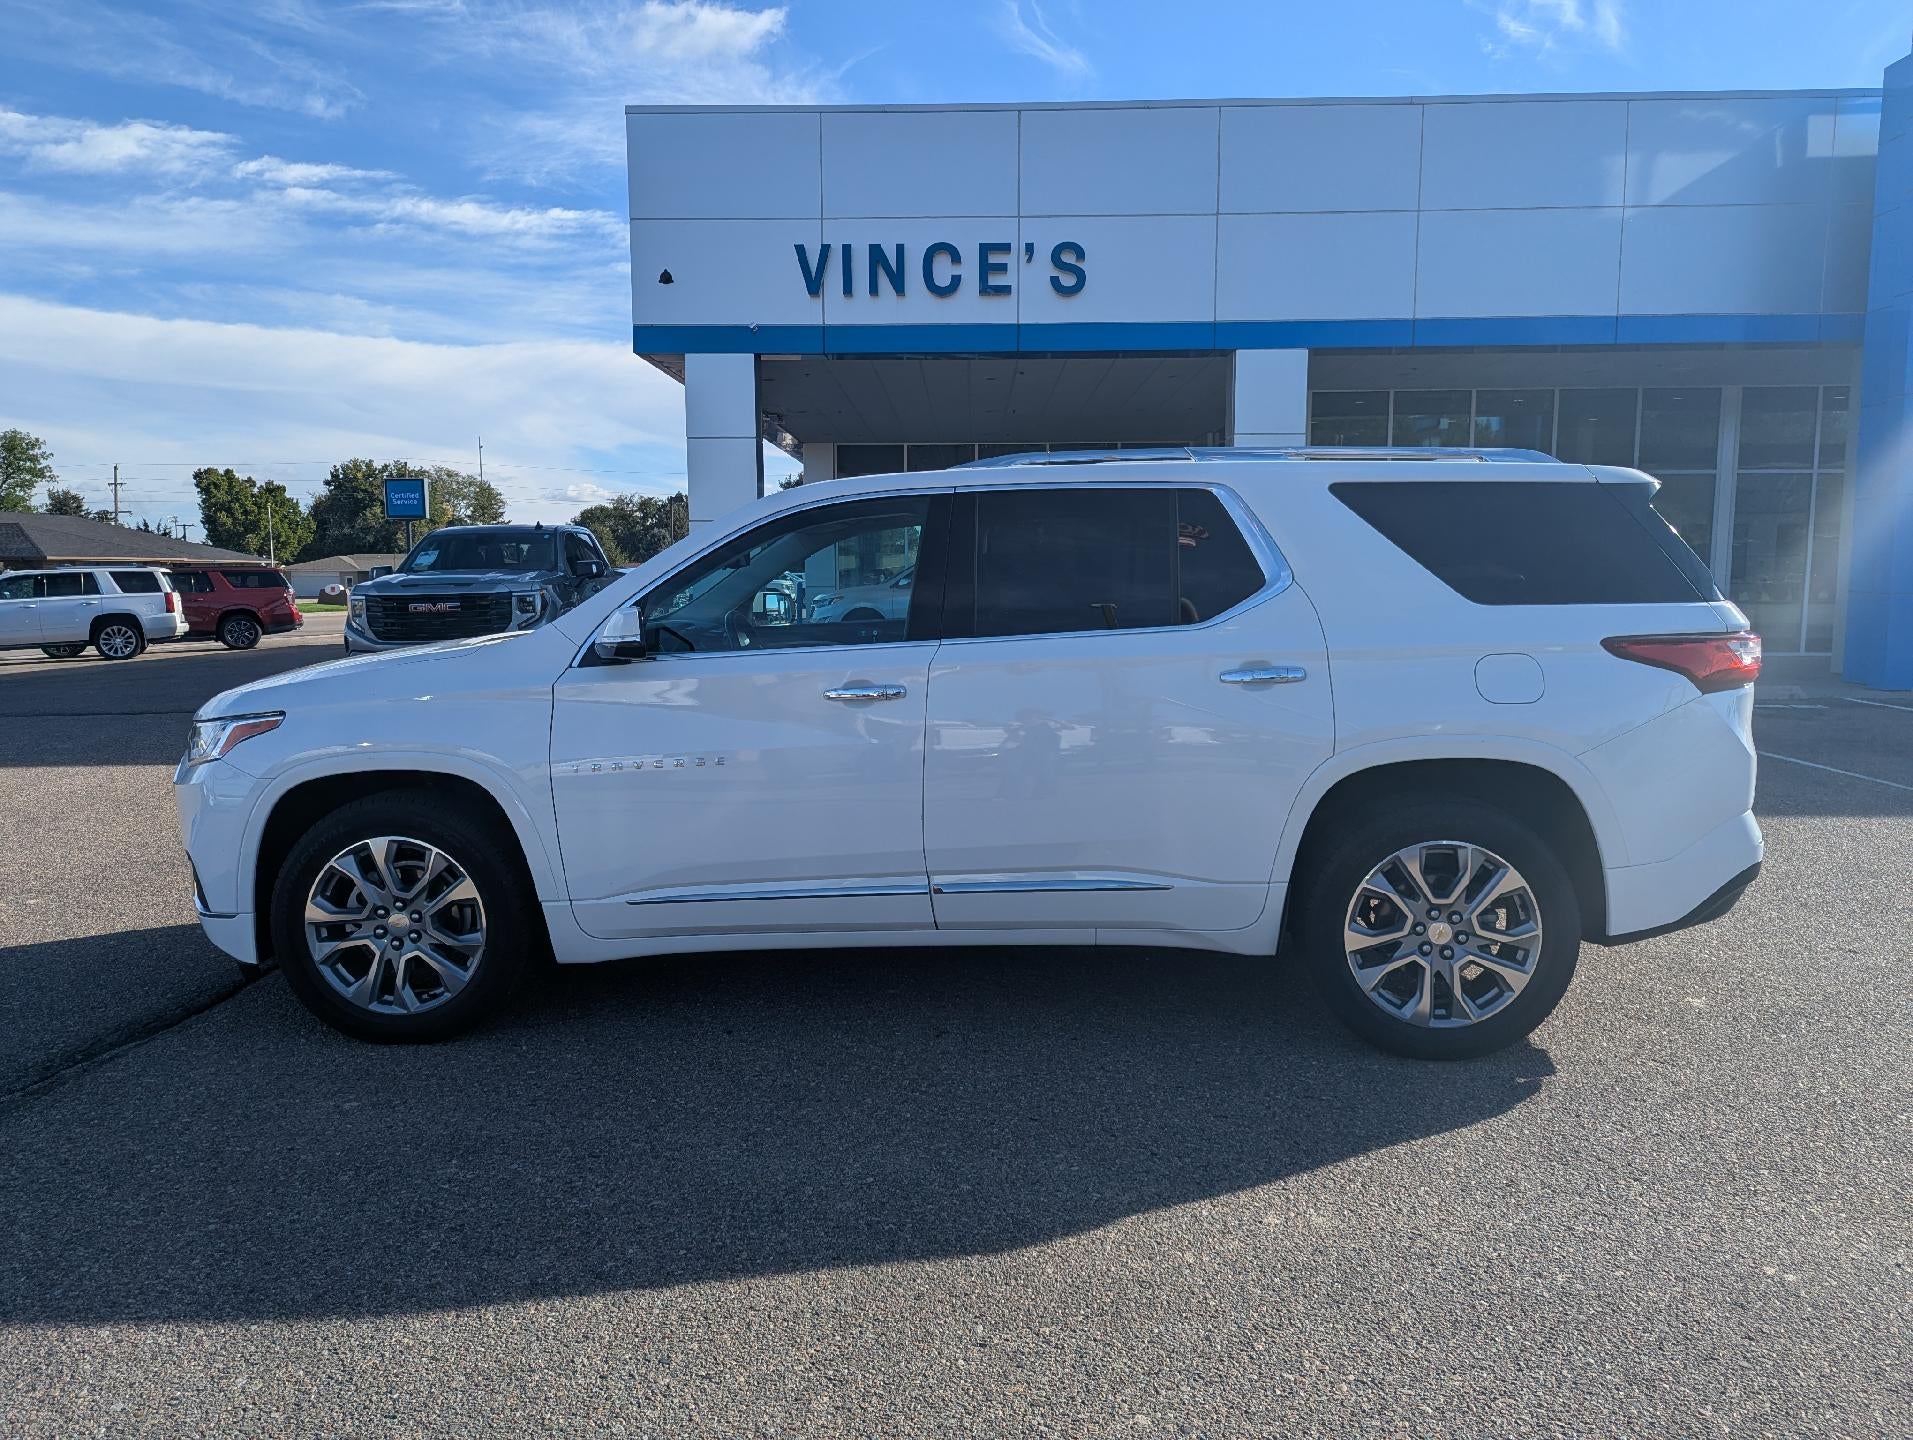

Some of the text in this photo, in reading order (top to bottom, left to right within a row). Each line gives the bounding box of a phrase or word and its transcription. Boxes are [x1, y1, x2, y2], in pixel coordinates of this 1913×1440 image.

[793, 241, 1087, 297] VINCE'S
[408, 602, 461, 613] GMC
[571, 756, 726, 774] TRAVERSE
